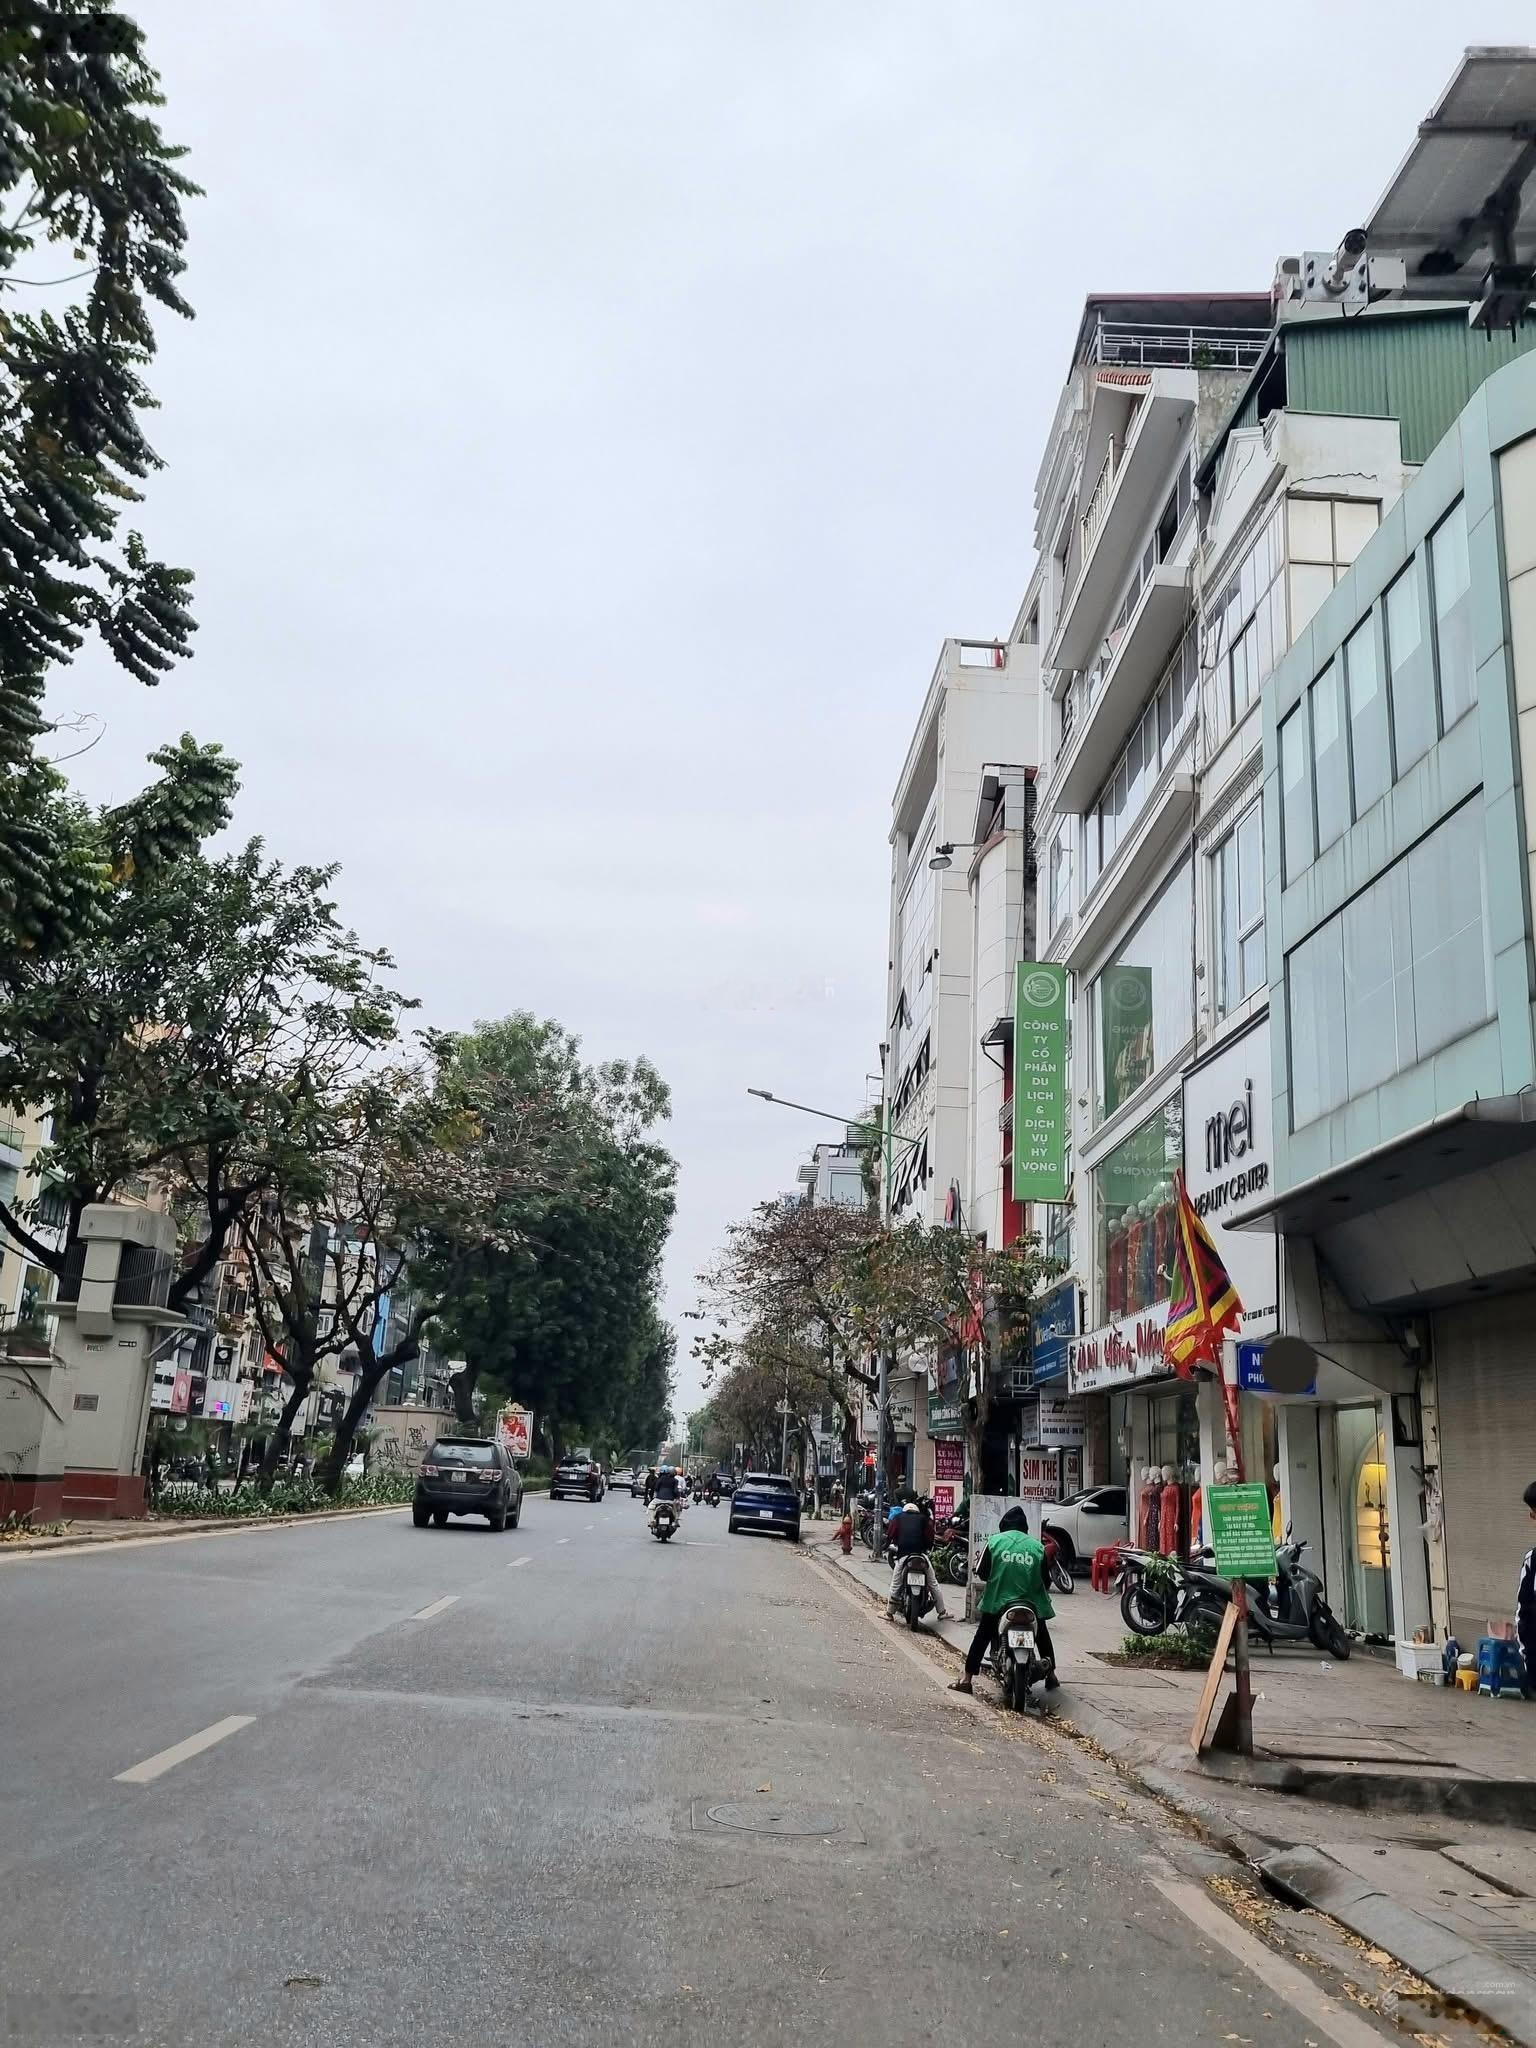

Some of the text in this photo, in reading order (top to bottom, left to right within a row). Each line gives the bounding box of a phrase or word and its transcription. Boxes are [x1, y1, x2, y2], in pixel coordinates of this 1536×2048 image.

[1023, 1019, 1059, 1031] CÔNG
[1033, 1035, 1048, 1044] TY
[1031, 1077, 1049, 1086] DU
[1027, 1091, 1054, 1102] LỊCH
[1036, 1105, 1044, 1114] &
[1024, 1119, 1055, 1130] DỊCH
[1205, 1078, 1254, 1173] mei
[1031, 1133, 1048, 1145] VỤ
[1031, 1147, 1048, 1157] HY
[1021, 1162, 1058, 1174] VỌNG
[1229, 1162, 1269, 1202] CENTER
[1023, 1453, 1058, 1481] SIM THẺ
[1001, 1550, 1034, 1566] Grab
